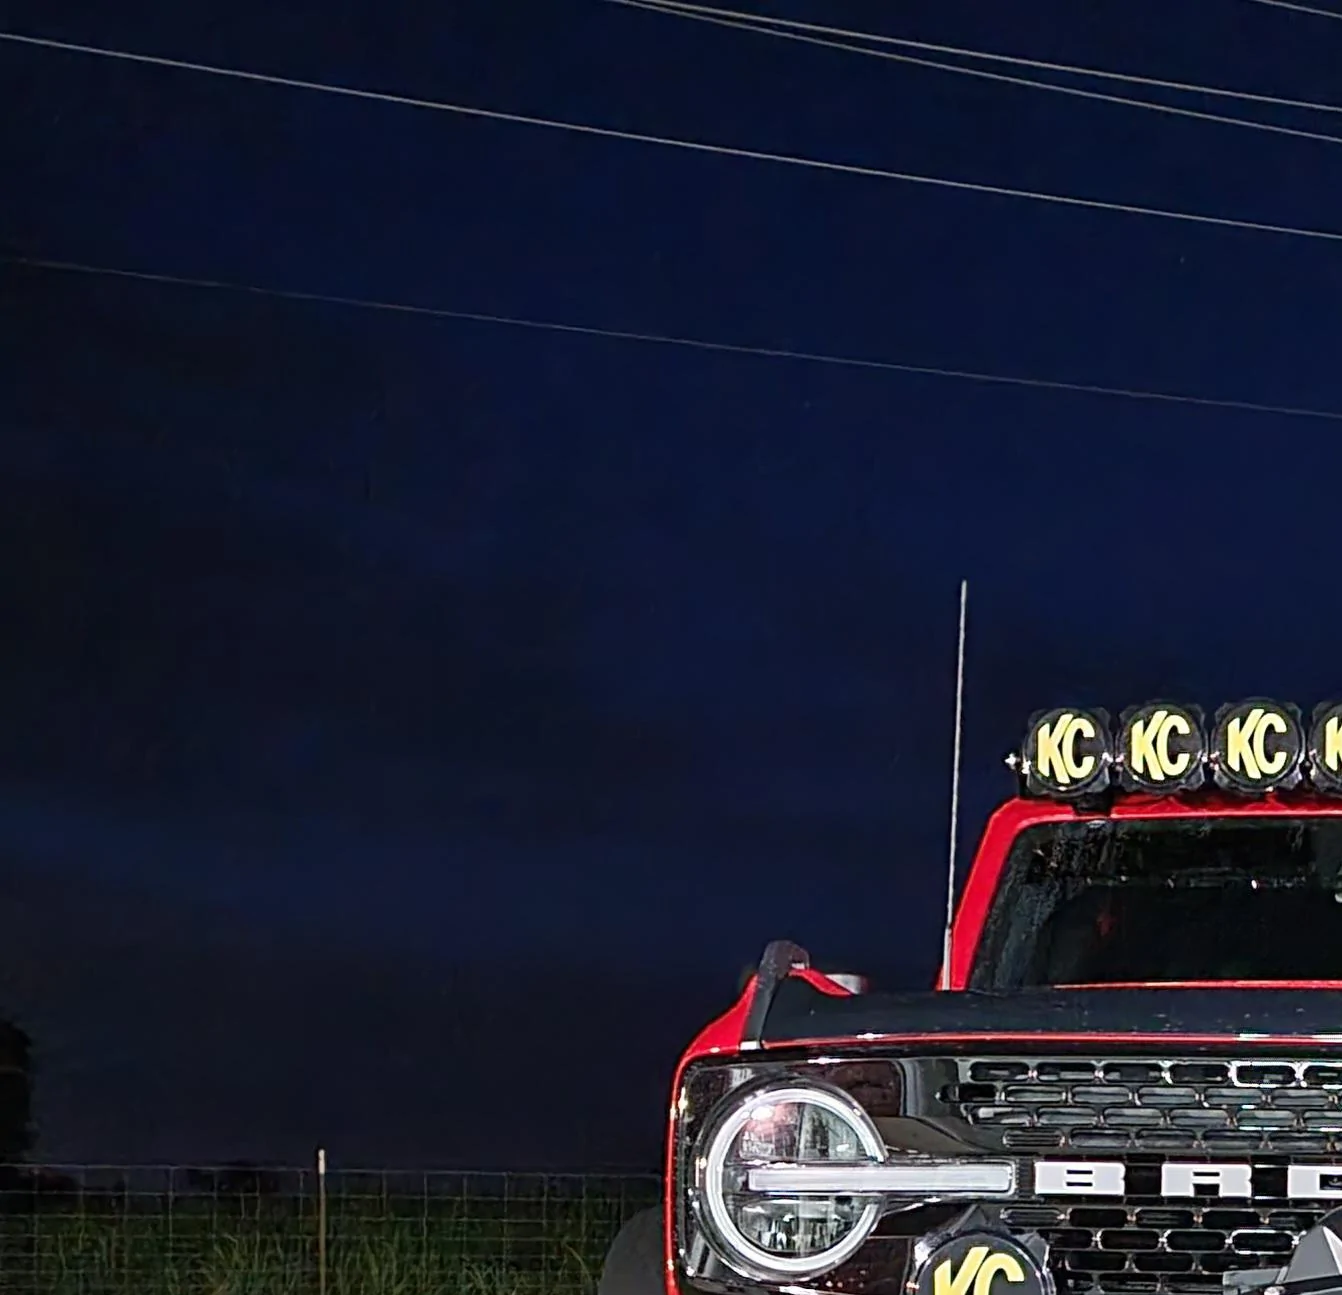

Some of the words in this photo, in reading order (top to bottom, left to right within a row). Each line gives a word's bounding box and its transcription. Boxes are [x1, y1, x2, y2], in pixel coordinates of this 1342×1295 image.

[1038, 713, 1095, 784] KC
[1131, 710, 1190, 781] KC
[1227, 708, 1287, 779] KC
